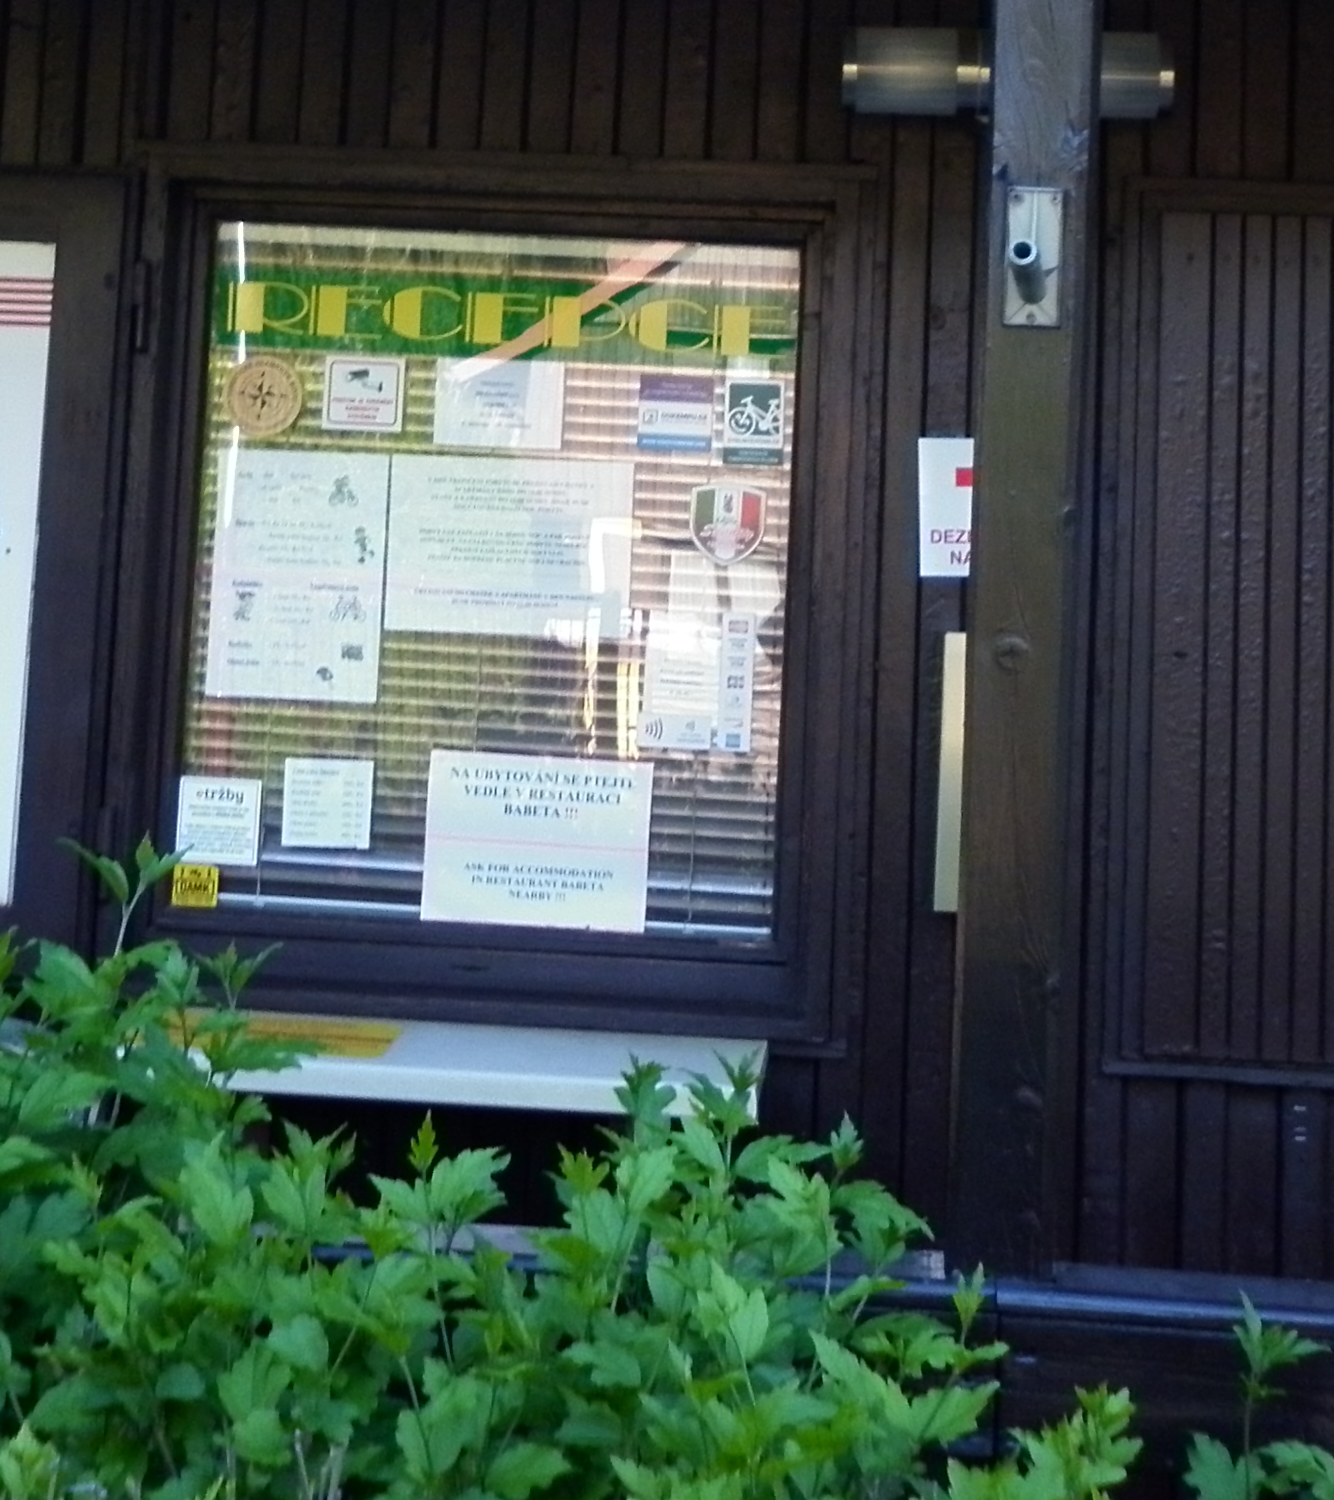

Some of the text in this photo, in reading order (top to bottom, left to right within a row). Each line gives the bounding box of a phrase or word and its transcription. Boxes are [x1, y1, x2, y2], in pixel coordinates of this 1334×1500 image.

[227, 281, 790, 357] RECEPCE
[451, 766, 470, 780] NA
[563, 773, 580, 786] SE
[464, 783, 622, 806] VEDLE V RESTAURACI
[503, 802, 561, 819] BABETA
[463, 861, 614, 880] ASK FOR ACCOMMODATION
[471, 874, 605, 892] IN RESTAURANT BABETA
